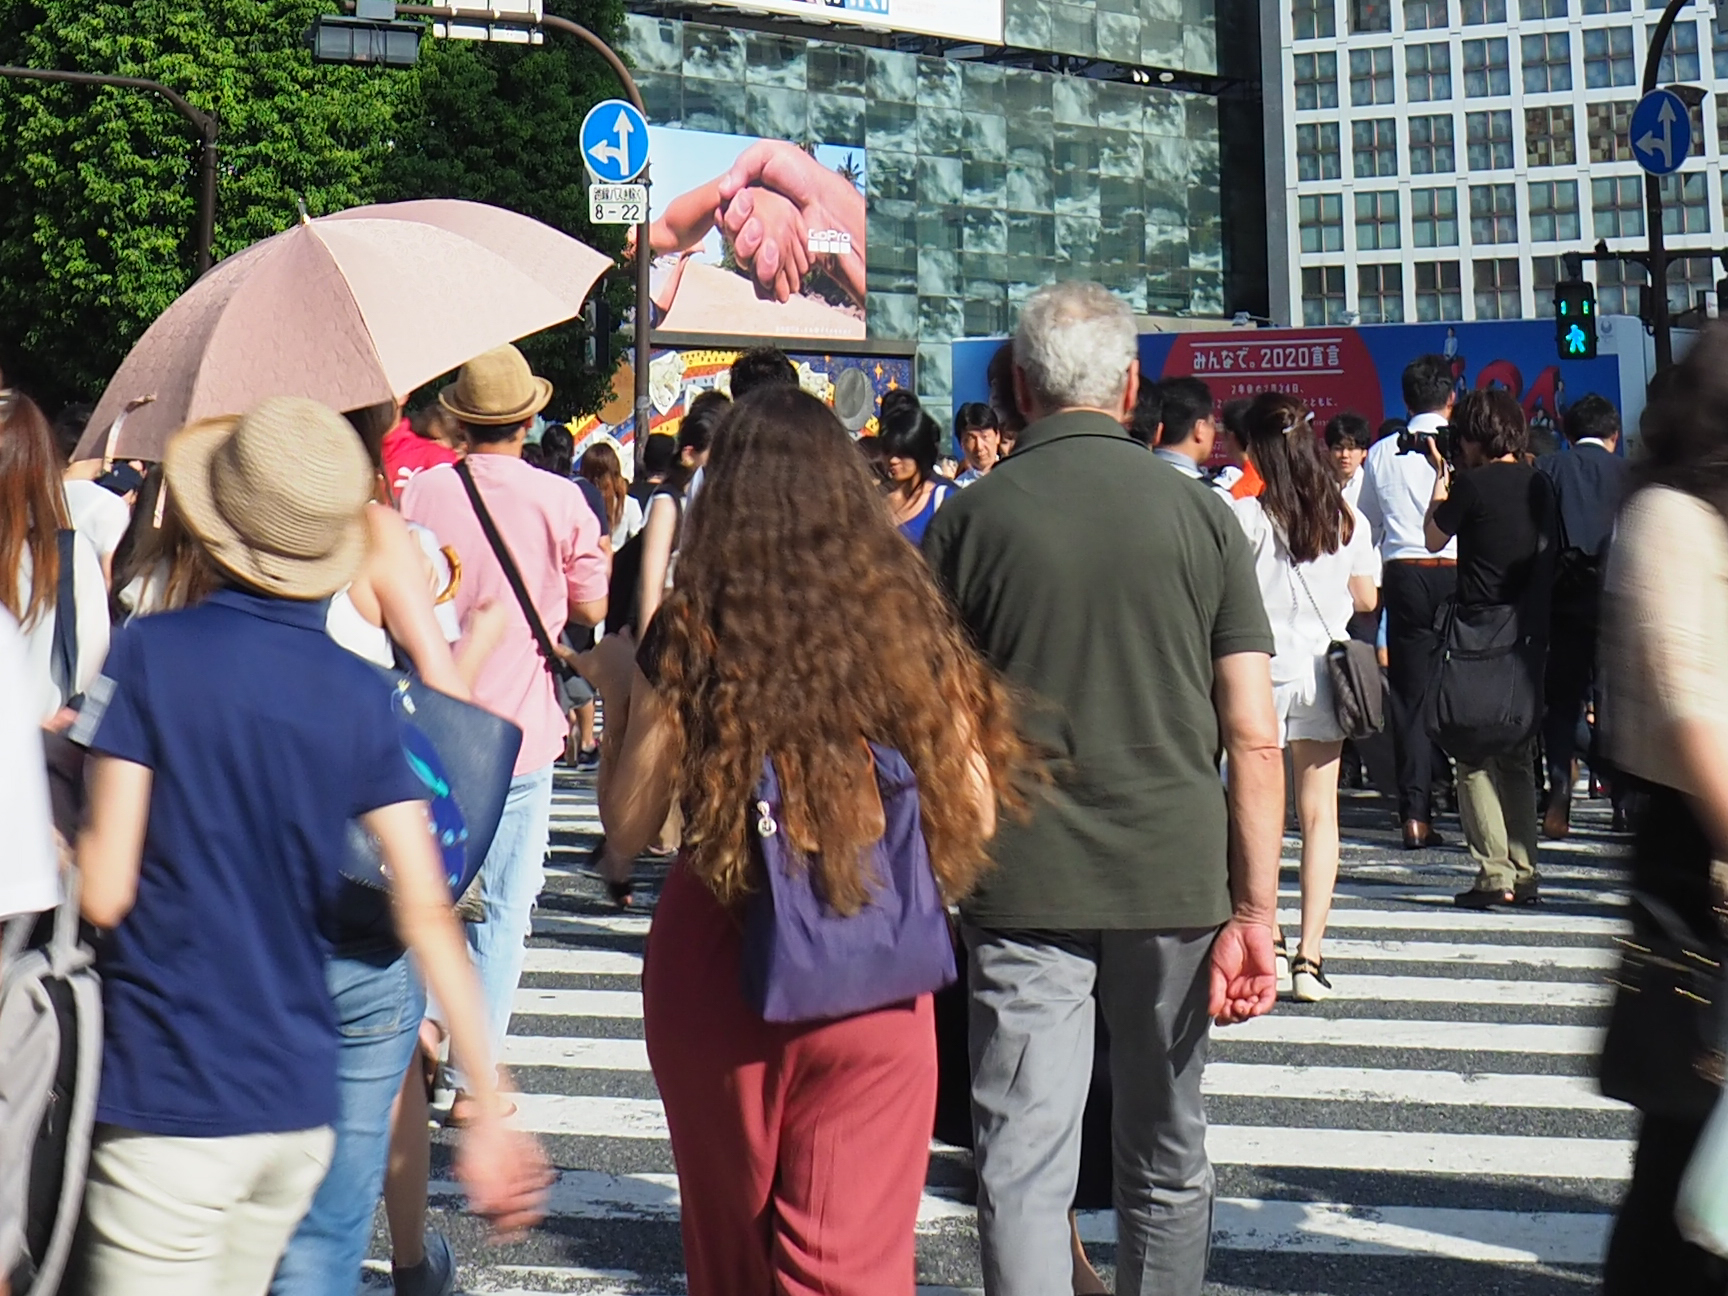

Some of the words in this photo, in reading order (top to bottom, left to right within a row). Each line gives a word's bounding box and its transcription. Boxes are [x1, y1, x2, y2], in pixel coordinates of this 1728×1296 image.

[808, 228, 852, 241] GoPro
[1193, 345, 1340, 370] みんなで。2020宣言
